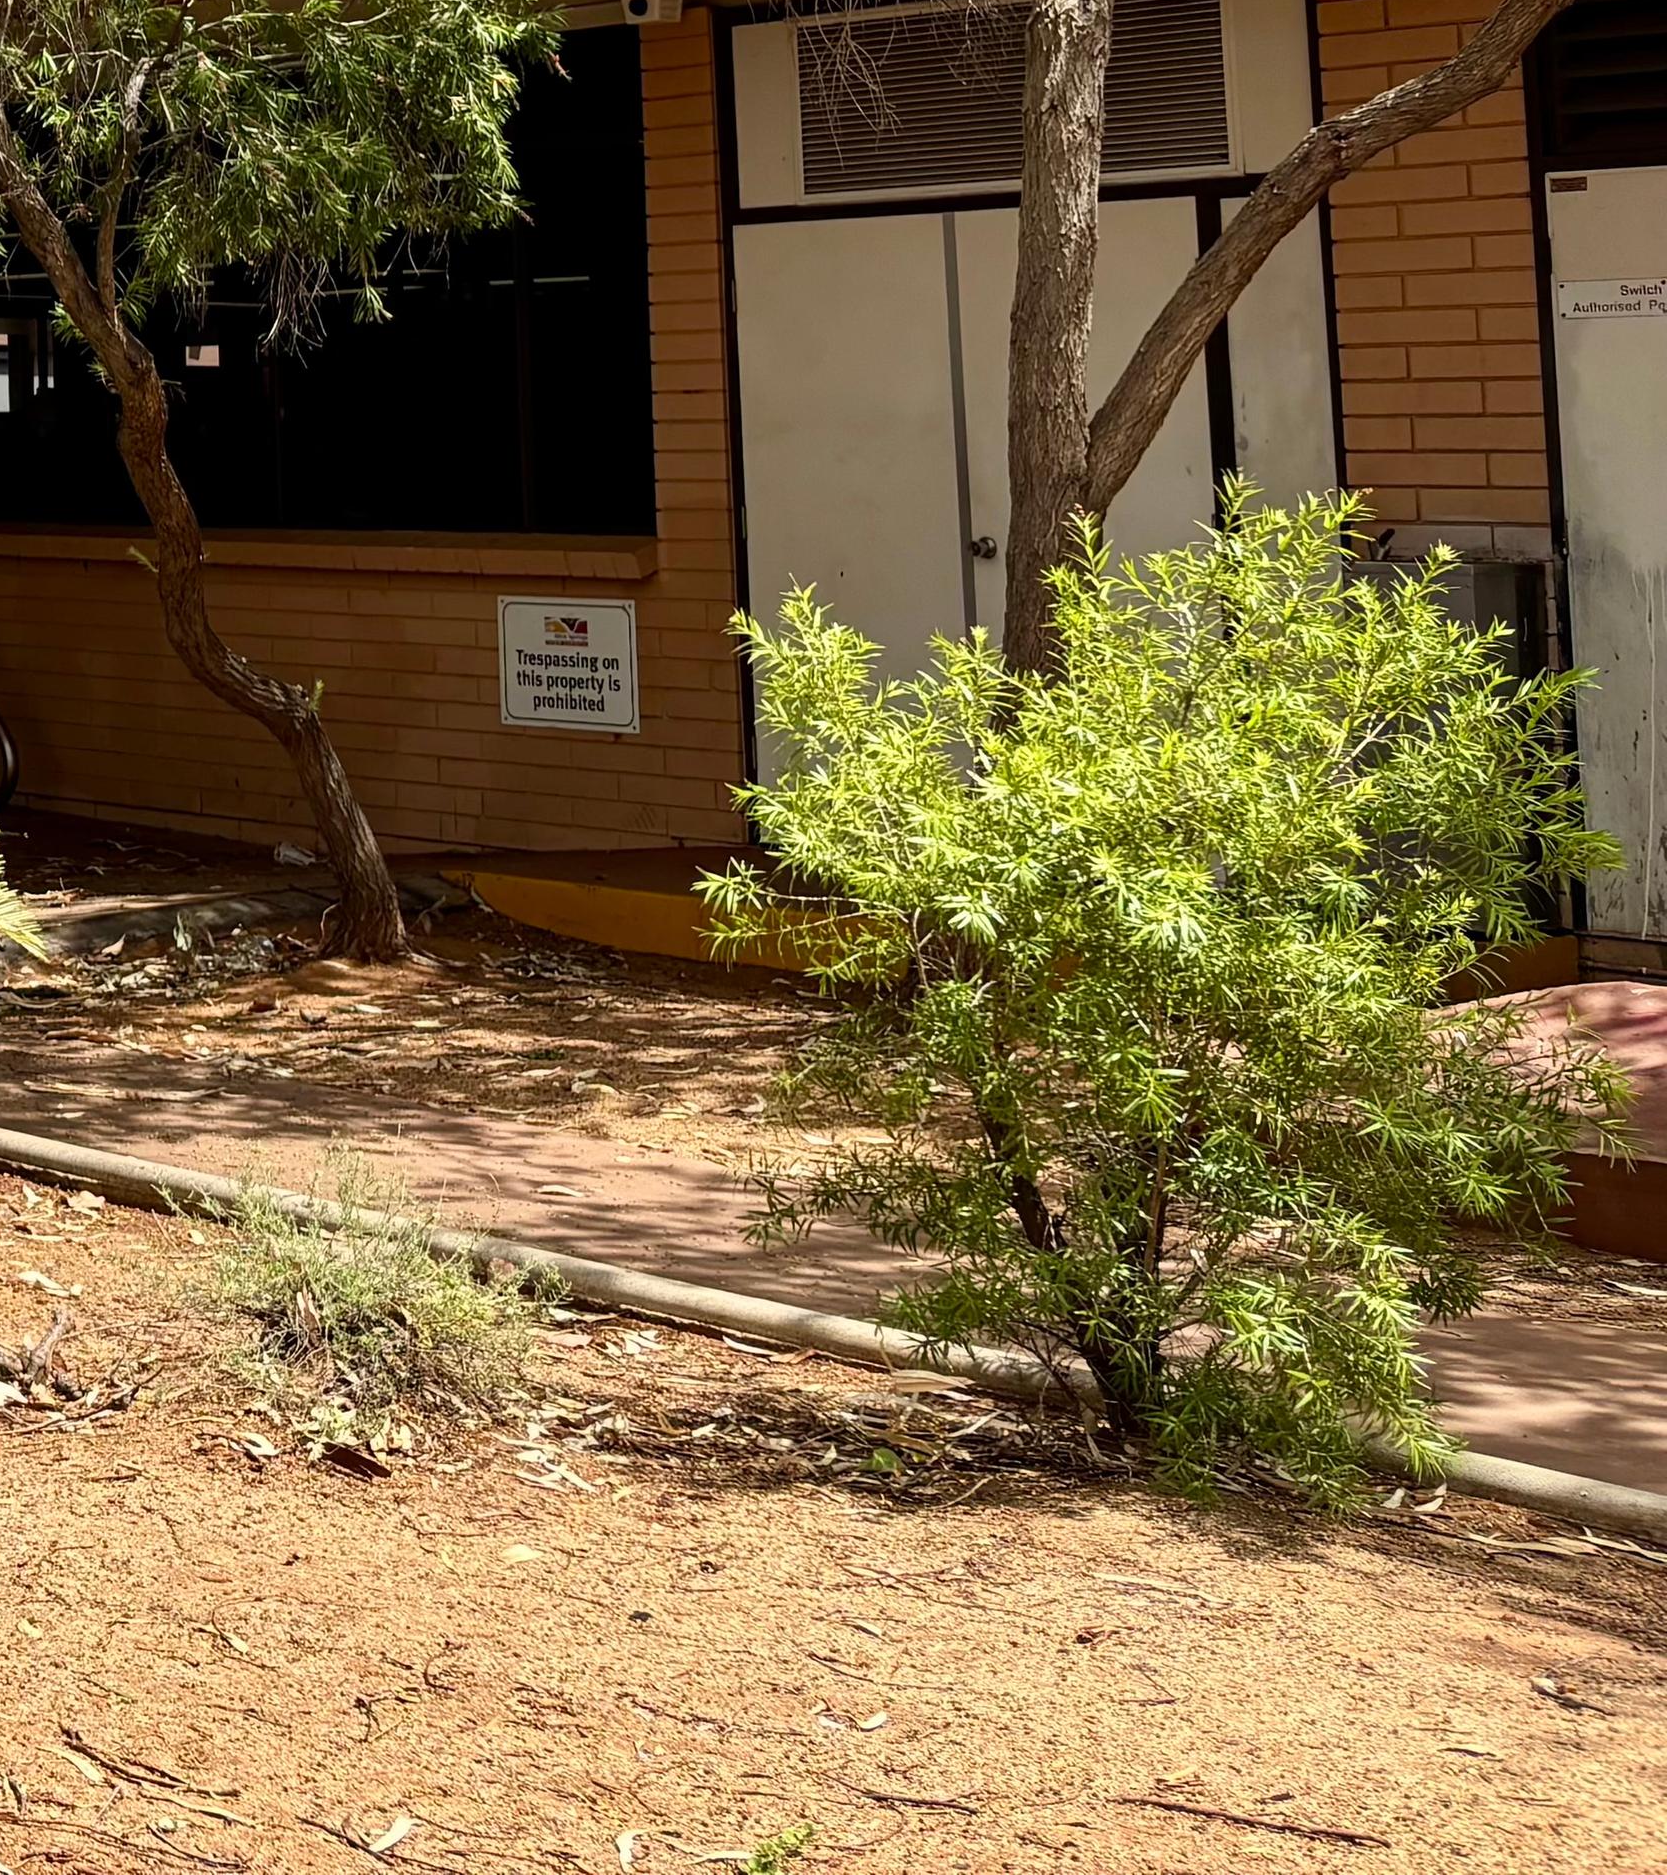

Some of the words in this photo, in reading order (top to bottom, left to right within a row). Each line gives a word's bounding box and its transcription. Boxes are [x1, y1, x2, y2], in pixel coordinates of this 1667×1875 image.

[1620, 284, 1663, 296] Switch
[1572, 300, 1641, 313] Authorised
[516, 649, 599, 673] Trespassing
[602, 657, 620, 671] on
[516, 670, 543, 687] this
[546, 674, 605, 695] property
[608, 674, 621, 692] is
[533, 693, 605, 713] prohibited
